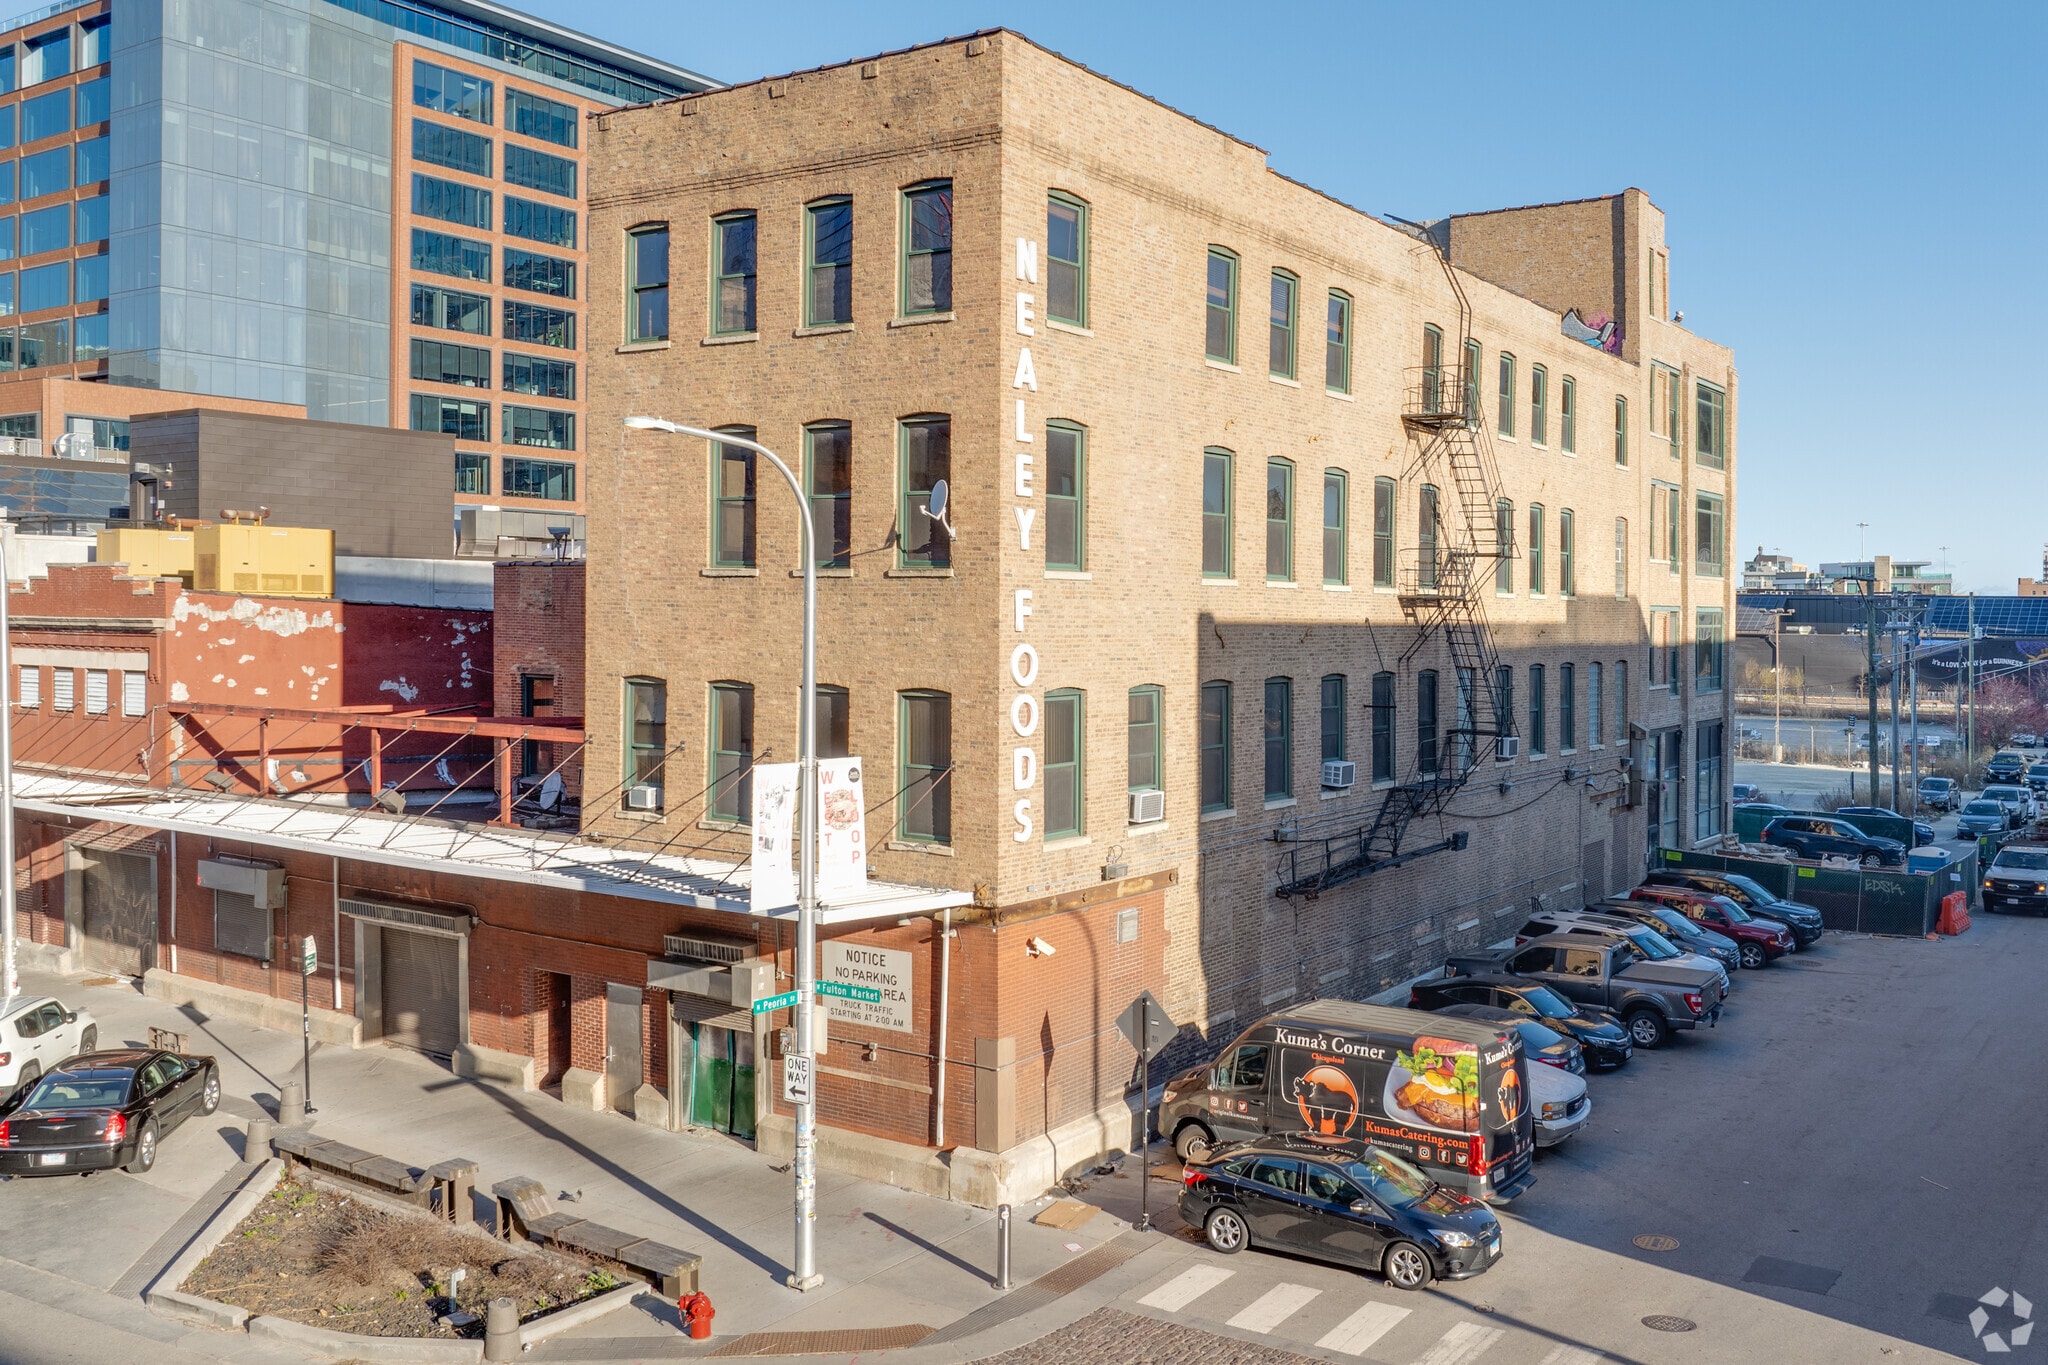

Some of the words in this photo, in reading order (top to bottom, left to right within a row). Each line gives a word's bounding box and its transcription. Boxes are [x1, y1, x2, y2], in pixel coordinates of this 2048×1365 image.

[1013, 237, 1038, 551] NEALEY
[1010, 589, 1039, 843] FOODS
[820, 770, 834, 846] WEST
[846, 949, 886, 967] NOTICE
[835, 966, 849, 978] NO
[852, 969, 897, 986] PARKING
[822, 983, 847, 996] Fulton
[851, 988, 878, 1001] Market
[878, 988, 907, 1003] REA
[763, 997, 787, 1011] Peoria
[840, 999, 861, 1010] TRUCK
[865, 1003, 893, 1016] TRAFFIC
[830, 1008, 861, 1020] STARTING
[864, 1014, 872, 1022] AT
[893, 1019, 904, 1027] AM
[1275, 1027, 1328, 1050] Kuma's
[1331, 1037, 1386, 1060] Corner
[787, 1058, 807, 1072] ONE
[787, 1071, 808, 1084] WAY
[1365, 1120, 1469, 1149] KumasCatering.com
